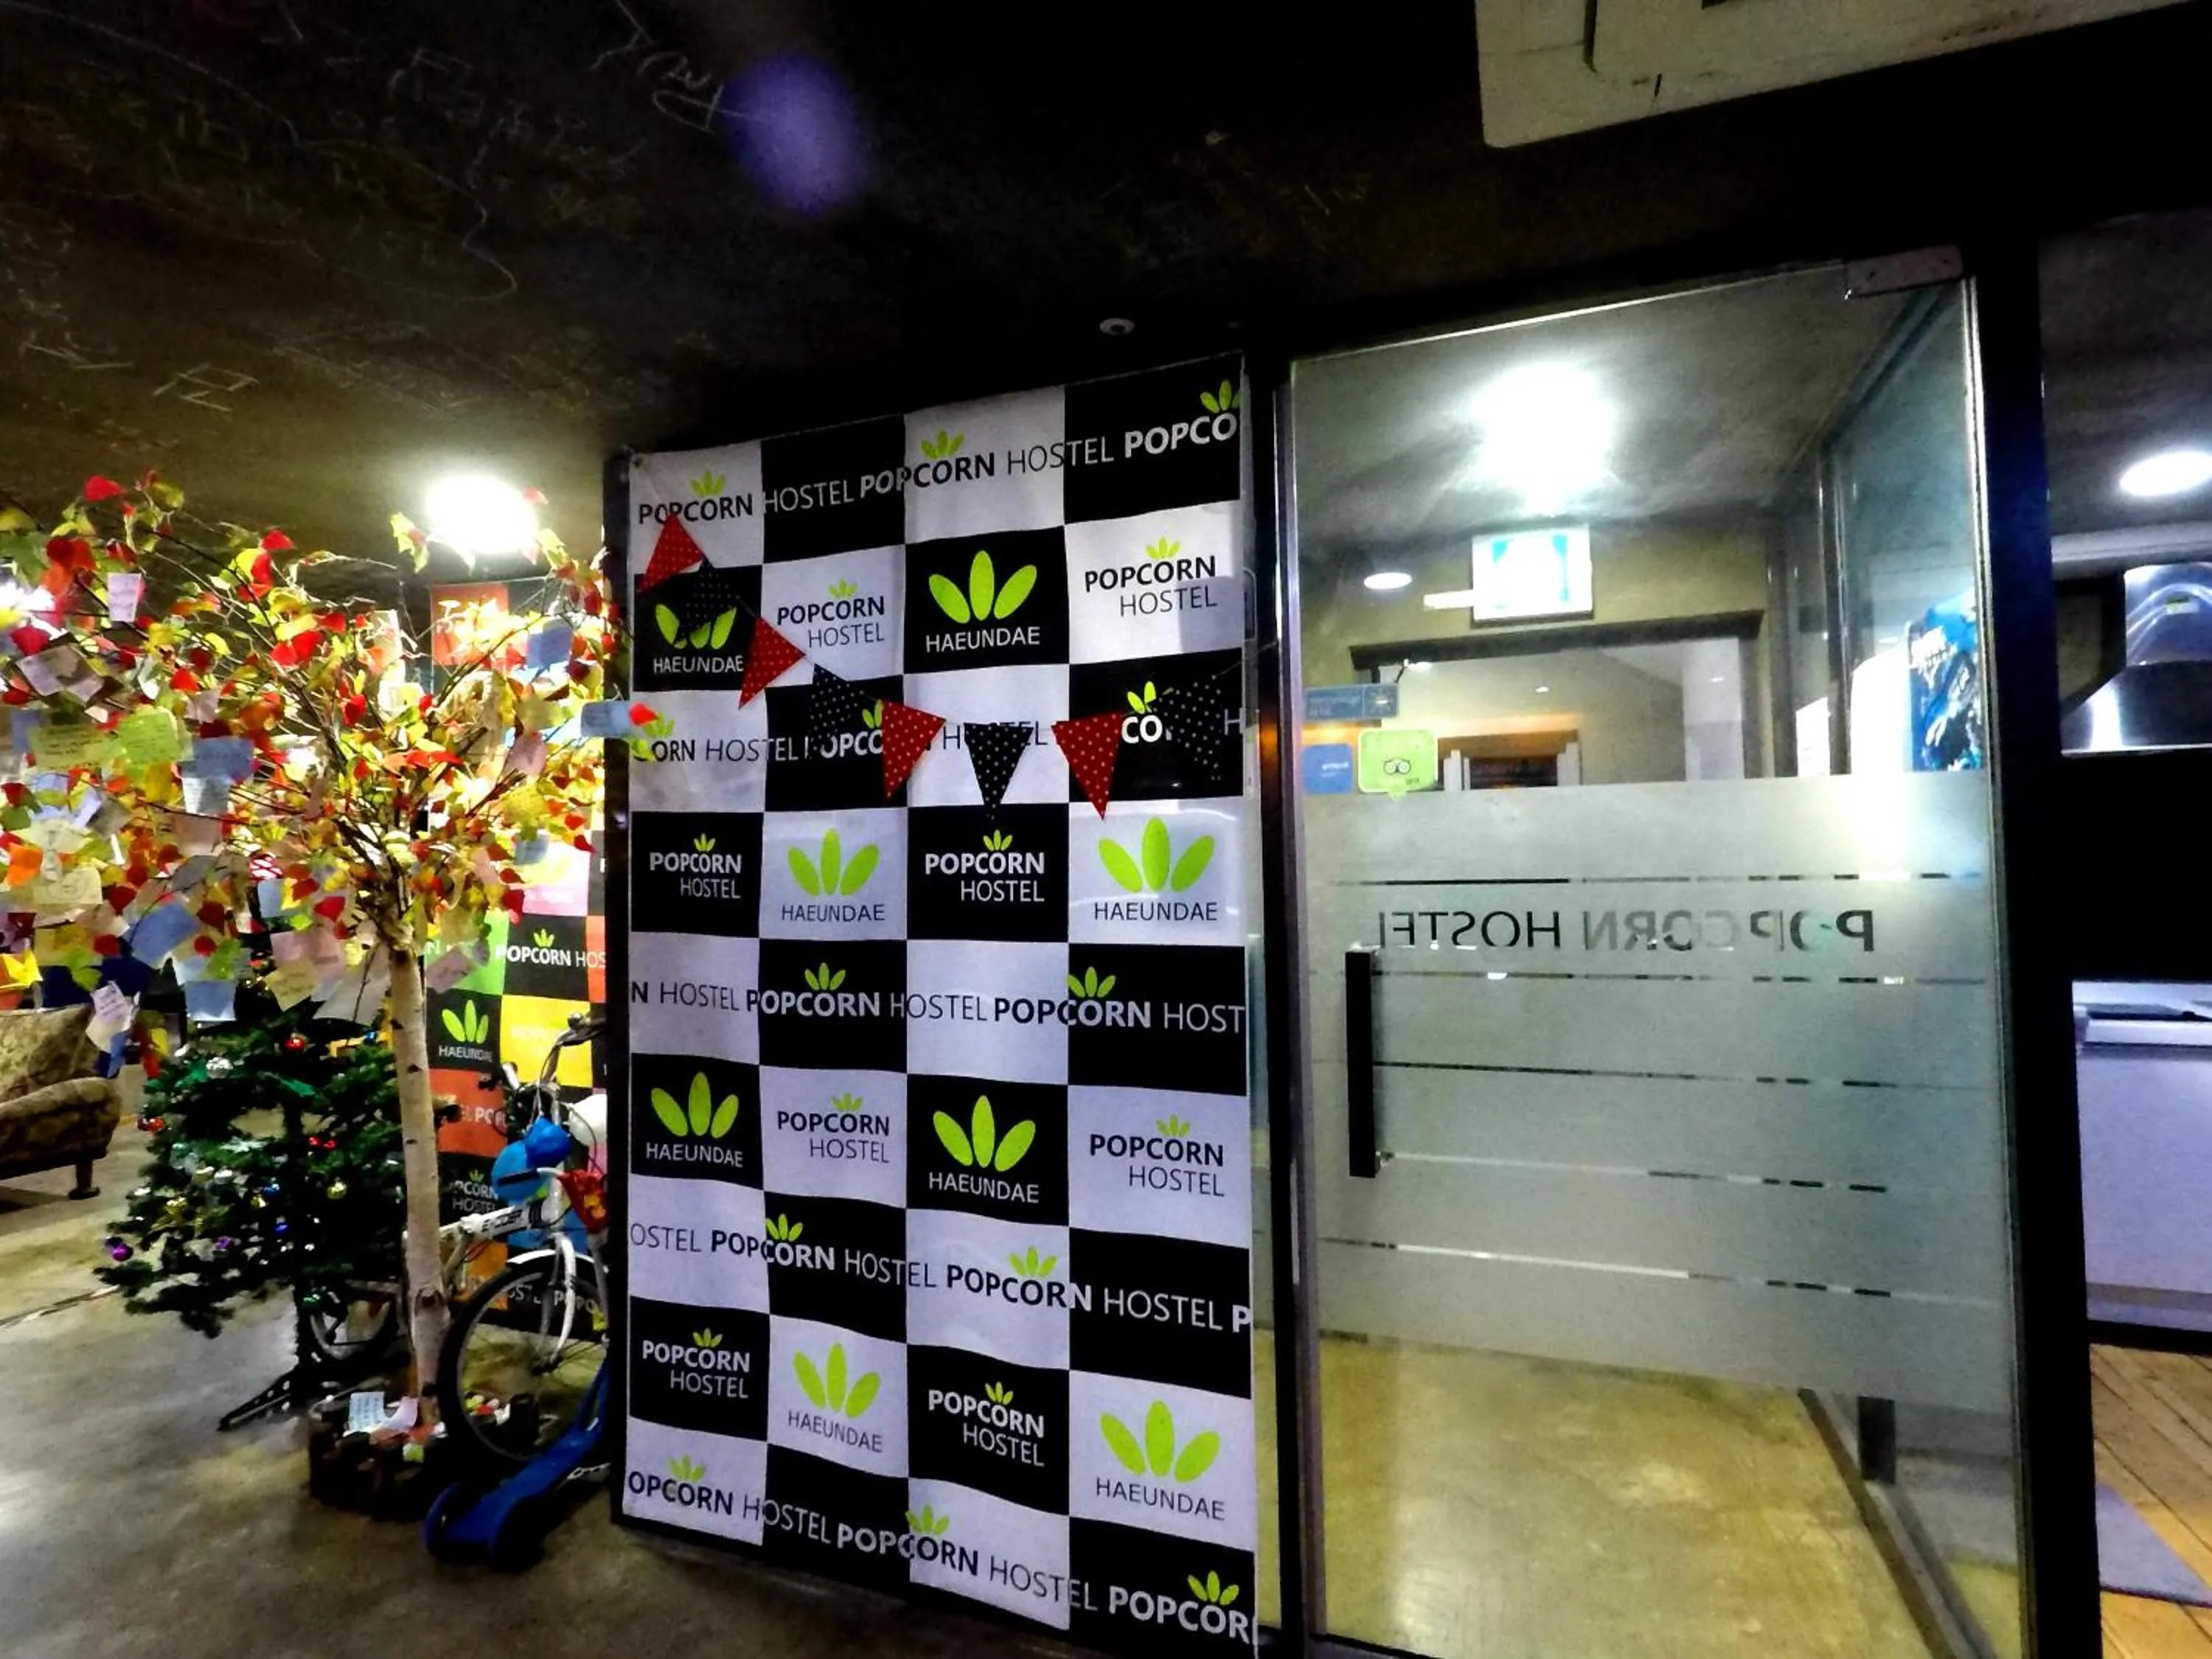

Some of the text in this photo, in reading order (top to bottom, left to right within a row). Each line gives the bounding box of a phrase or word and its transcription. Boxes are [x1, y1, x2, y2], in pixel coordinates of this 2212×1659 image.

[639, 412, 1238, 525] POPCORN HOSTEL POPCORN HOSTEL POPCO
[1084, 554, 1217, 594] POPCORN
[776, 595, 886, 626] POPCORN
[1120, 585, 1218, 618] HOSTEL
[808, 622, 886, 649] HOSTEL
[925, 626, 1040, 653] HAEUNDAE
[653, 654, 744, 674] HAEUNDAE
[634, 739, 695, 762] ORN
[705, 737, 799, 762] HOSTEL
[649, 851, 742, 875] POPCORN
[925, 852, 1045, 875] POPCORN
[680, 877, 741, 900] HOSTEL
[960, 880, 1045, 903] HOSTEL
[782, 902, 886, 923] HAEUNDAE
[1094, 902, 1218, 922] HAEUNDAE
[660, 982, 740, 1011] HOSTEL
[746, 990, 880, 1018] POPCORN
[890, 992, 987, 1021] HOSTEL
[995, 998, 1151, 1029] POPCORN
[1164, 1002, 1245, 1033] HOST
[776, 1110, 890, 1136] POPCORN
[646, 1142, 744, 1168] HAEUNDAE
[810, 1138, 890, 1164] HOSTEL
[1089, 1134, 1224, 1166] POPCORN
[928, 1172, 1039, 1203] HAEUNDAE
[1129, 1164, 1225, 1197] HOSTEL
[630, 1223, 702, 1253] OSTEL
[711, 1229, 835, 1271] POPCORN
[844, 1251, 936, 1289] HOSTEL
[947, 1265, 1092, 1312] POPCORN
[1104, 1287, 1223, 1331] HOSTEL
[642, 1340, 751, 1374] POPCORN
[670, 1369, 748, 1399] HOSTEL
[928, 1389, 1045, 1439] POPCORN
[788, 1410, 883, 1453] HAEUNDAE
[964, 1422, 1045, 1467] HOSTEL
[1096, 1478, 1225, 1521] HAEUNDAE
[628, 1471, 733, 1516] OPCORN
[742, 1494, 831, 1544] HOSTEL
[838, 1523, 978, 1576] POPCORN
[990, 1557, 1098, 1613] HOSTEL
